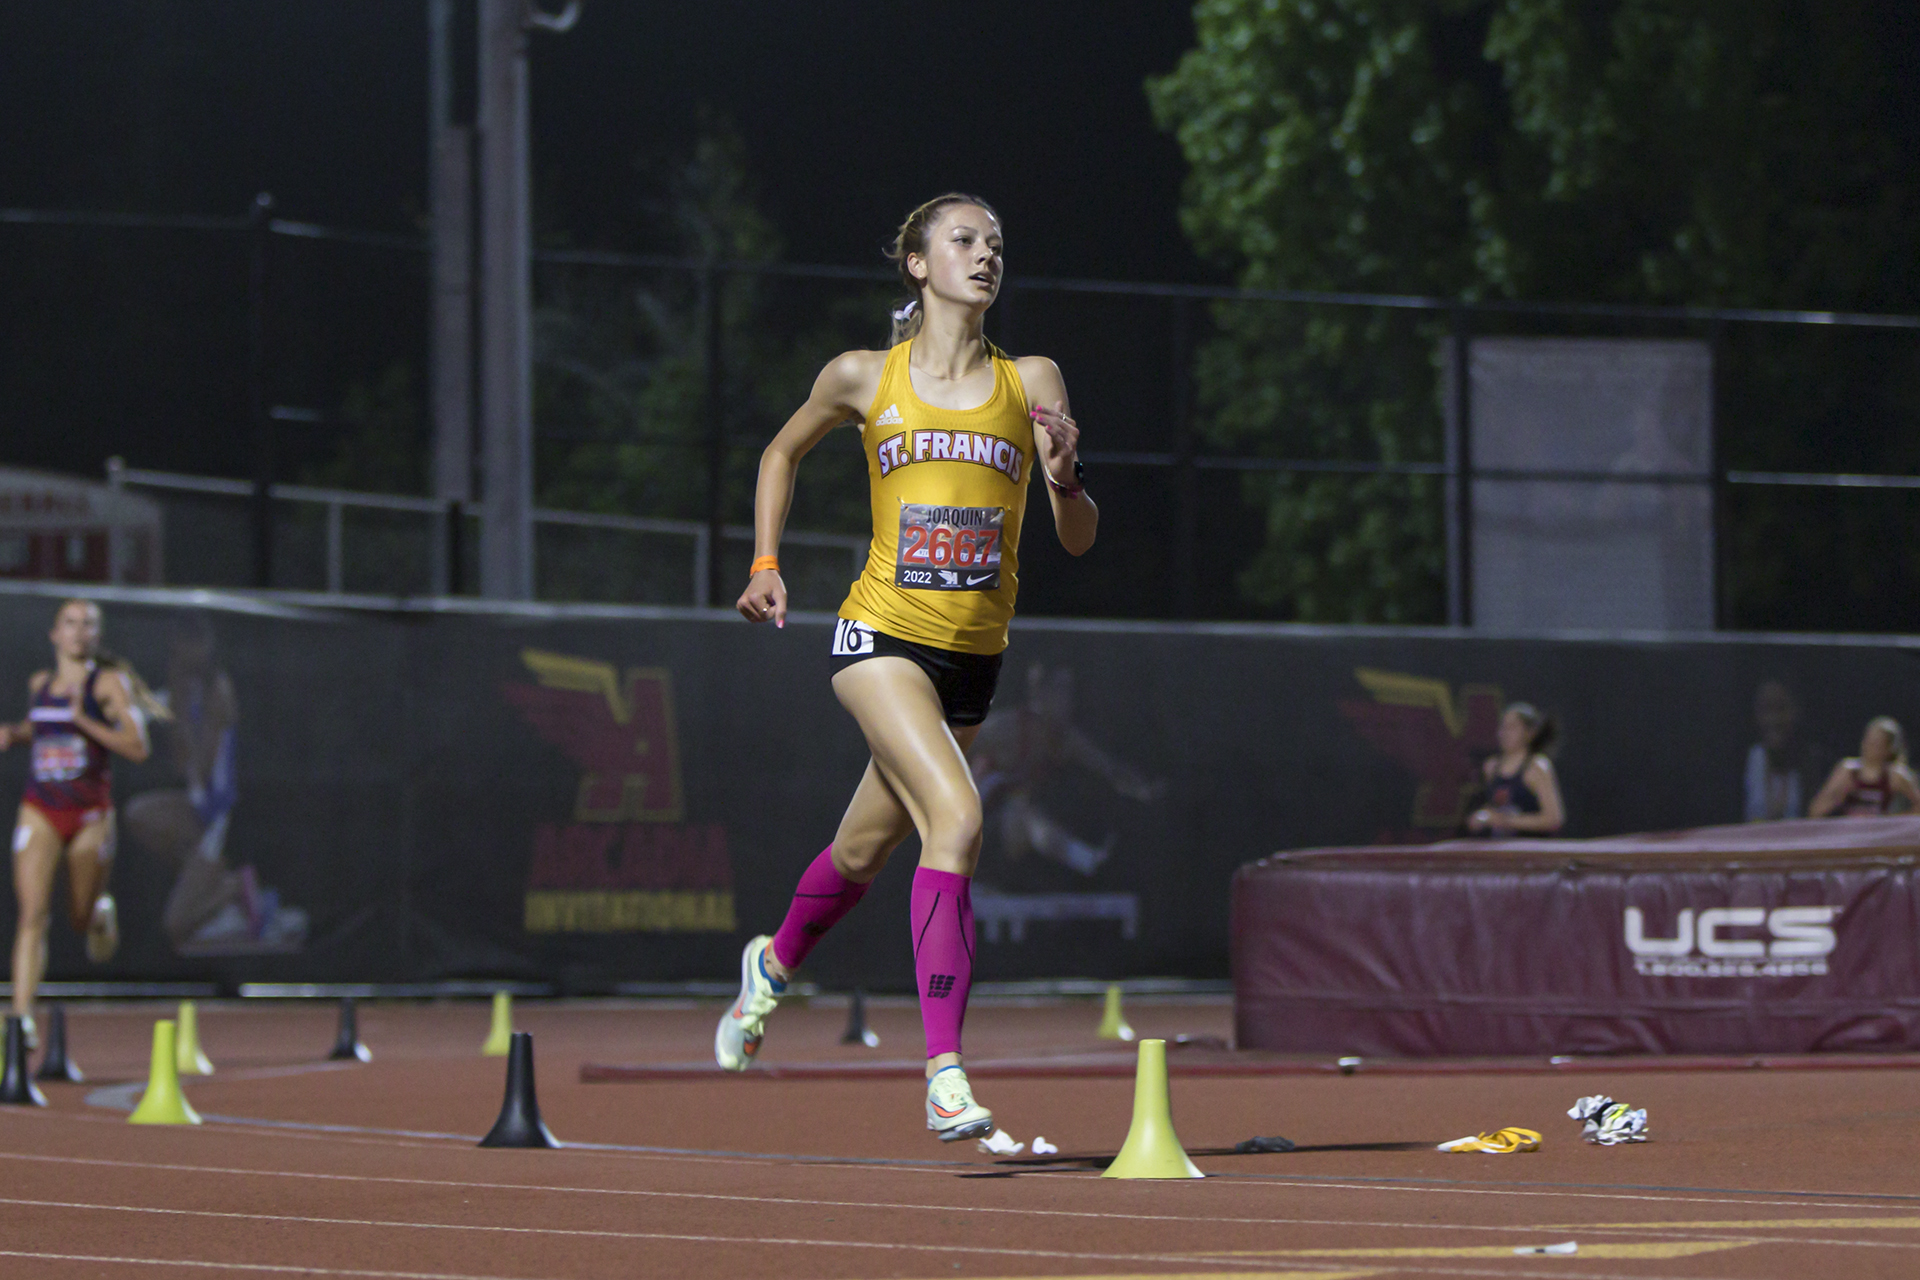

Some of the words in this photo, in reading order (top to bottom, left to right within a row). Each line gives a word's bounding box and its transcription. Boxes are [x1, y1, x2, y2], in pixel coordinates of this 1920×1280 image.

[878, 431, 911, 479] ST.
[912, 429, 1024, 485] FRANCIS
[926, 507, 983, 528] JOAQUIN
[902, 525, 999, 567] 2667
[903, 570, 932, 584] 2022
[840, 619, 862, 652] 16
[1624, 906, 1838, 957] UCS
